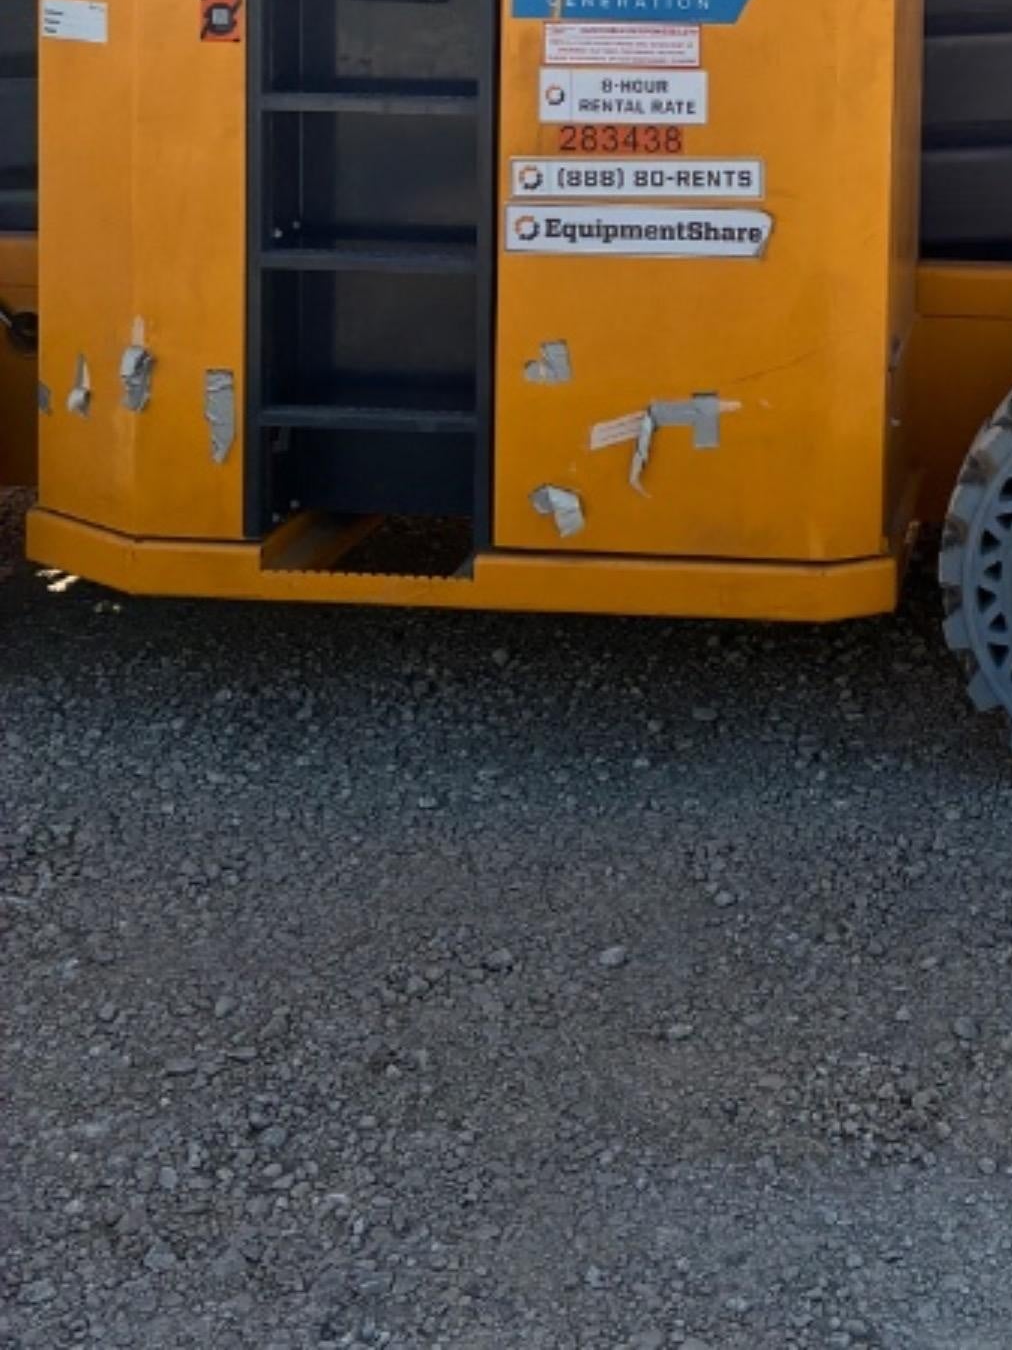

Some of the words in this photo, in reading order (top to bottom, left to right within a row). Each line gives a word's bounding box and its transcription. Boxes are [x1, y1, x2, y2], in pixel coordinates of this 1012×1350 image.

[602, 80, 669, 93] 8-HOUR
[578, 99, 645, 115] RENTAL
[650, 101, 697, 115] RATE
[560, 125, 683, 153] 283438
[557, 168, 625, 188] (888)
[634, 170, 752, 188] 80-RENTS
[545, 218, 763, 243] EquipmentShare
